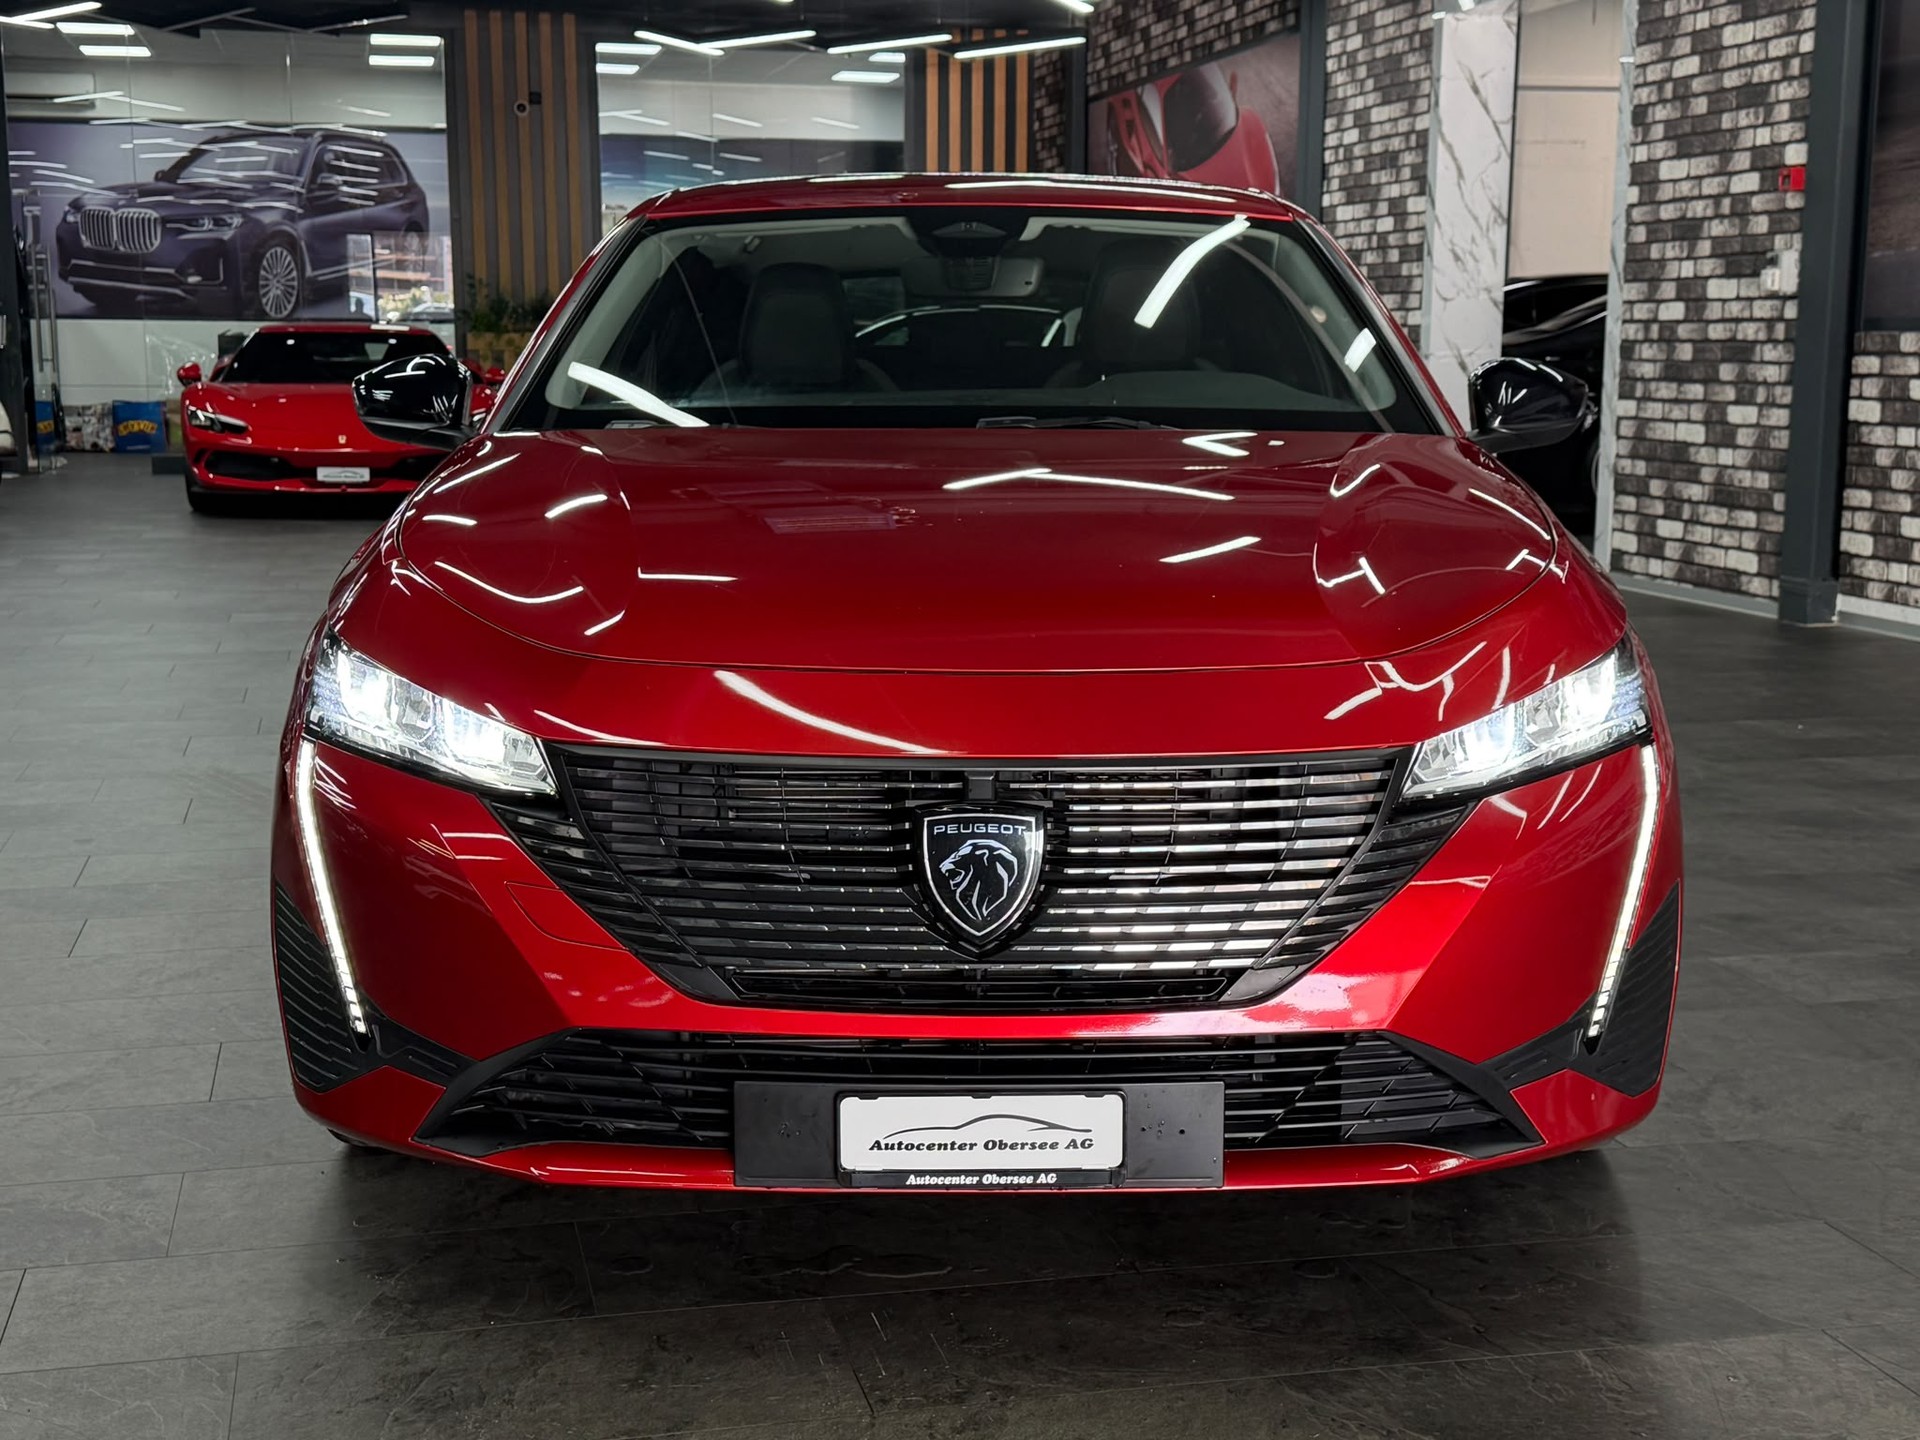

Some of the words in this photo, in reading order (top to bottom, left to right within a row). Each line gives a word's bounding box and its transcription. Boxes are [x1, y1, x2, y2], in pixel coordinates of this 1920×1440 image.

[933, 823, 1026, 835] PEUGEOT
[868, 1139, 978, 1151] Autocenter
[983, 1138, 1059, 1151] Obersee
[1064, 1138, 1094, 1150] AG
[905, 1174, 979, 1186] Autocenter
[982, 1173, 1034, 1185] Obersee
[1036, 1173, 1057, 1184] AG
